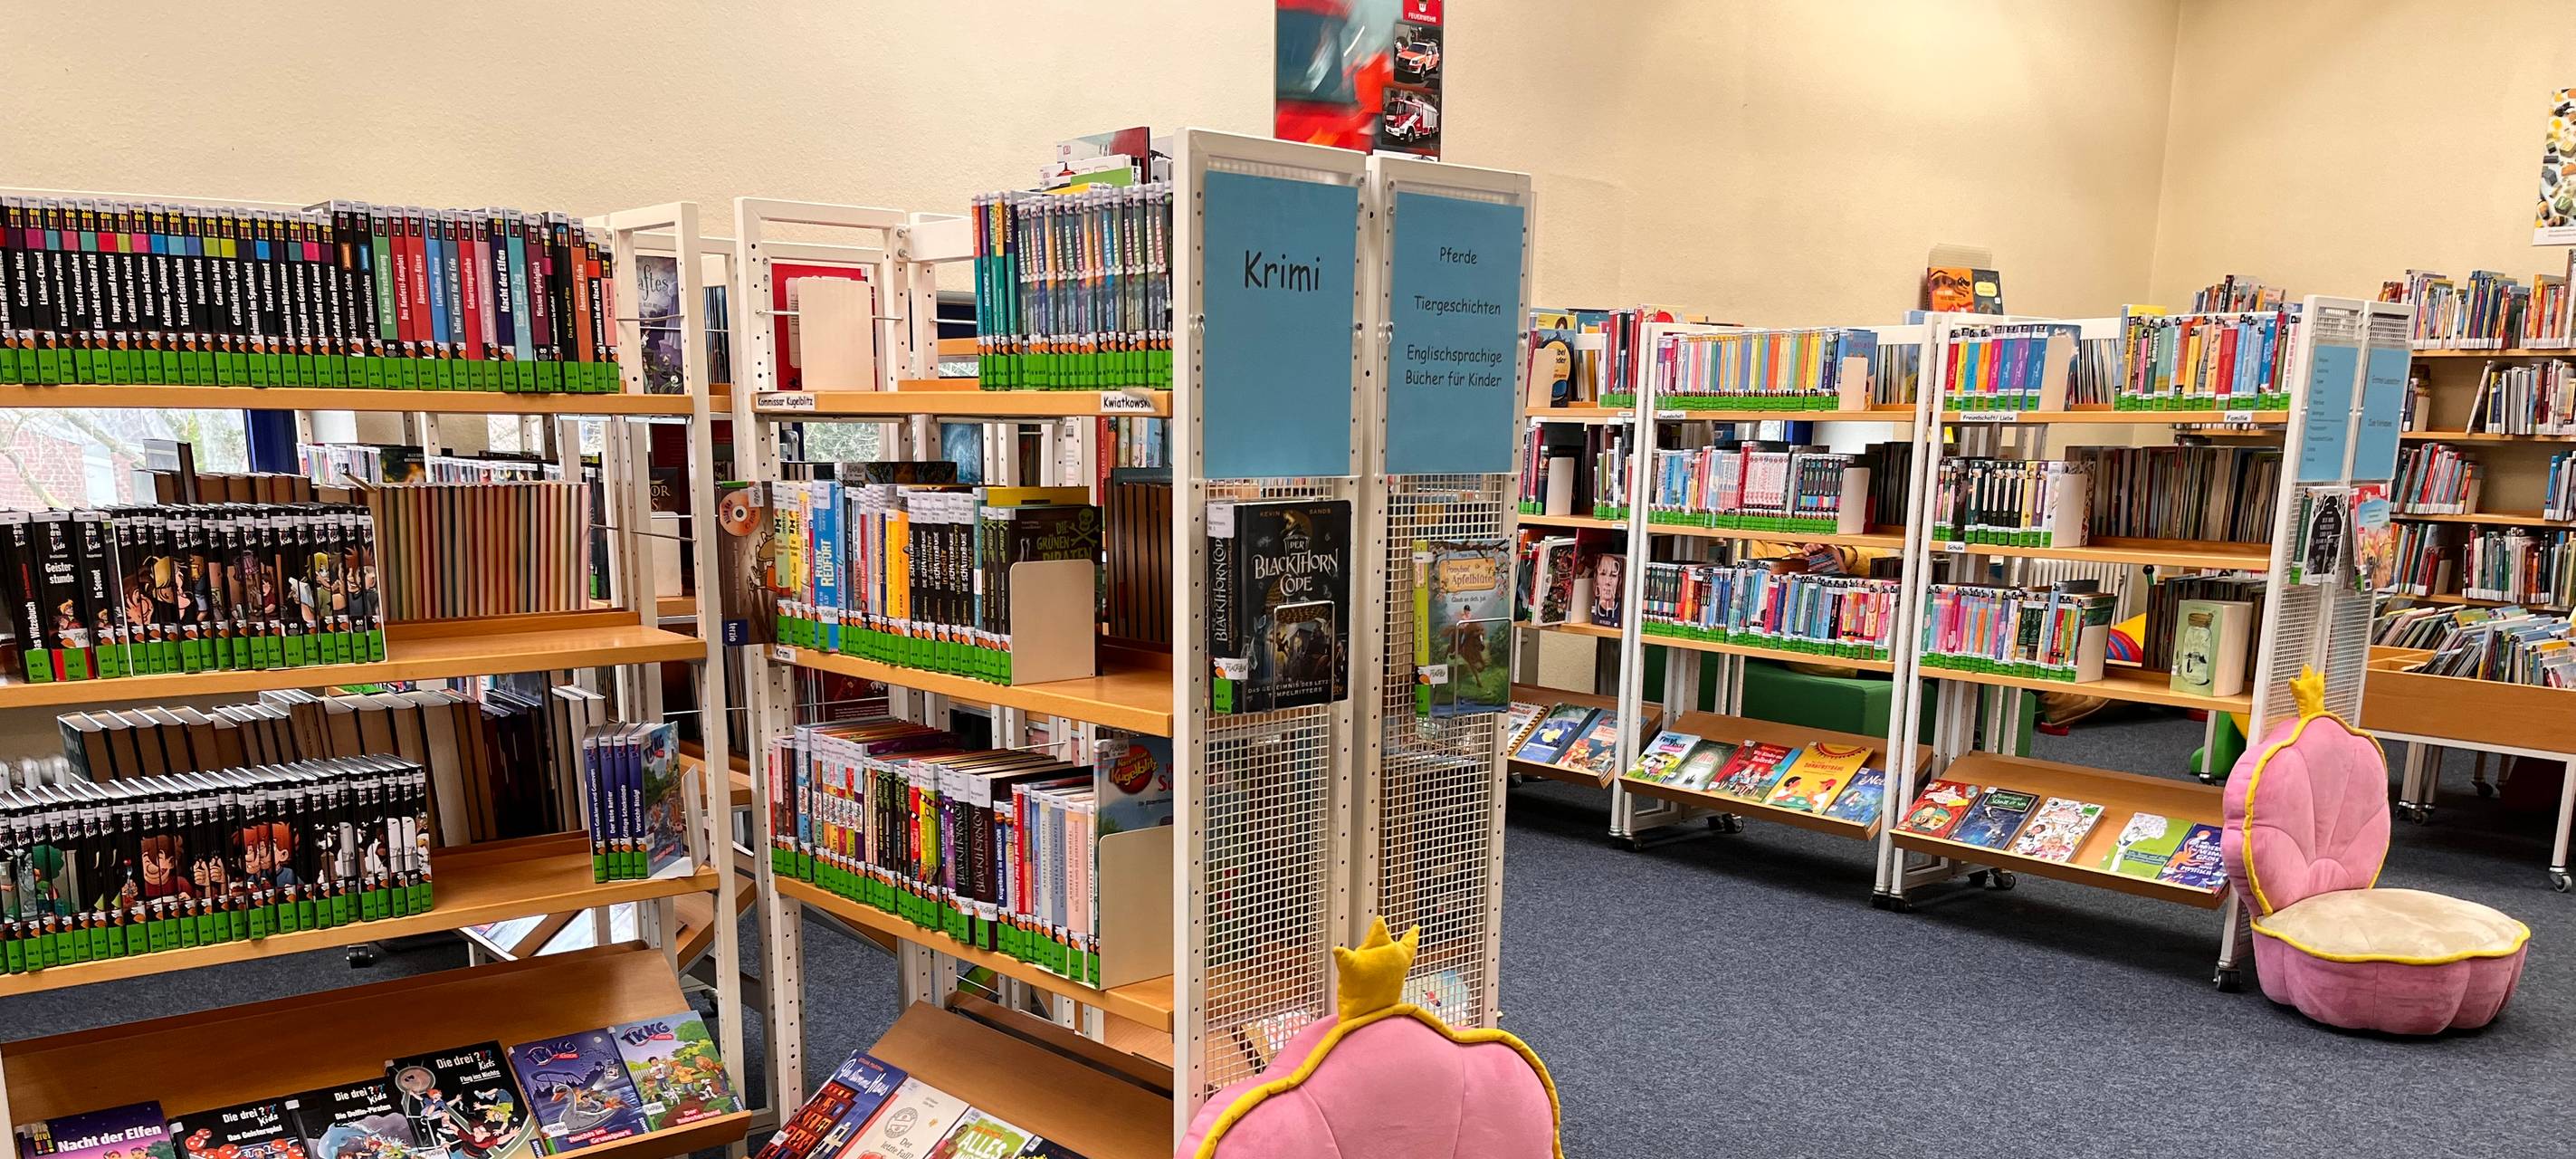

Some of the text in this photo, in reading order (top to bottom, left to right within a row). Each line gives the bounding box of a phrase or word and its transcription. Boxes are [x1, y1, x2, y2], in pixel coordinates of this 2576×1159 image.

[1408, 12, 1436, 23] FEUERWEHR
[212, 260, 220, 273] Not
[1439, 246, 1477, 264] Pferde
[15, 252, 29, 306] Gefahr im Netz
[34, 252, 48, 305] Liebes-Chaos!
[194, 259, 205, 304] Heuler in Not
[329, 265, 337, 292] Ruinen
[497, 250, 510, 312] Nacht der Elfen
[533, 262, 543, 293] Gipfelglück
[637, 264, 669, 301] aftes
[1244, 250, 1321, 292] Krimi
[72, 254, 85, 315] Tatort Kreuzfahrt
[87, 254, 103, 329] Ein echt schöner Fall
[106, 254, 121, 322] Klappe und Action!
[124, 256, 137, 322] Gefährliche Fracht
[141, 256, 154, 316] Küsse im Schnee
[157, 256, 172, 326] Achtung, Spionage!
[175, 259, 190, 326] Tatort Geisterbahn
[215, 282, 224, 305] Gorilla
[226, 261, 242, 325] Gefährliches Spiel
[244, 263, 257, 310] im Spukhotel
[262, 263, 273, 311] Tatort Filmset
[281, 263, 291, 314] im Düstermoor
[296, 264, 307, 313] am Geistersee
[311, 263, 323, 312] im Café Lomo!
[57, 282, 67, 311] geheime
[453, 294, 461, 315] Einsatz
[577, 283, 587, 311] Abenteuer
[1414, 296, 1501, 317] Tiergeschichten
[333, 314, 341, 337] Gefahr
[401, 310, 409, 320] Das
[453, 317, 462, 333] Voller
[1407, 344, 1503, 365] Englischsprachige
[1405, 369, 1502, 388] Bücher für Kinder
[758, 396, 813, 408] Kommissar Kugelblitz
[652, 485, 671, 497] OR
[52, 543, 65, 551] Kids
[1036, 534, 1070, 551] GRÜNEN
[1289, 541, 1304, 550] DER
[45, 561, 74, 573] Geister-
[815, 557, 823, 582] RUBY
[820, 547, 833, 590] REDFORT
[1253, 549, 1340, 580] BLACKTHORN
[49, 573, 74, 584] stunde
[91, 570, 102, 590] Seenot
[1279, 574, 1312, 596] CODE
[1453, 574, 1493, 588] Apfelblüte
[1213, 561, 1227, 641] BLACKTHORN
[25, 601, 40, 639] Witzebuch
[1110, 758, 1159, 786] Kugelblitz
[974, 826, 986, 893] BLACKTHORN
[621, 1021, 671, 1045] TKKG
[435, 1050, 491, 1068] Die drei ???
[526, 1041, 577, 1064] TKKG
[478, 1059, 495, 1071] Kids
[482, 1068, 501, 1078] Nichts
[351, 1088, 367, 1098] drei
[368, 1083, 386, 1094] ???
[367, 1093, 387, 1105] Kids
[223, 1105, 276, 1123] Die drei ???
[258, 1114, 279, 1126] Kids
[335, 1104, 392, 1123] Die Delfin-Piraten
[676, 1109, 721, 1124] Roboterhund
[34, 1132, 51, 1143] drei
[57, 1125, 162, 1154] Nacht der Elfen
[227, 1125, 283, 1142] Das Geisterspiel
[568, 1127, 606, 1143] Nachts im
[590, 1130, 634, 1145] Gruselpark
[900, 1138, 912, 1148] Der
[958, 1130, 1007, 1159] ALLES
[881, 1141, 914, 1159] letzte Fall?
